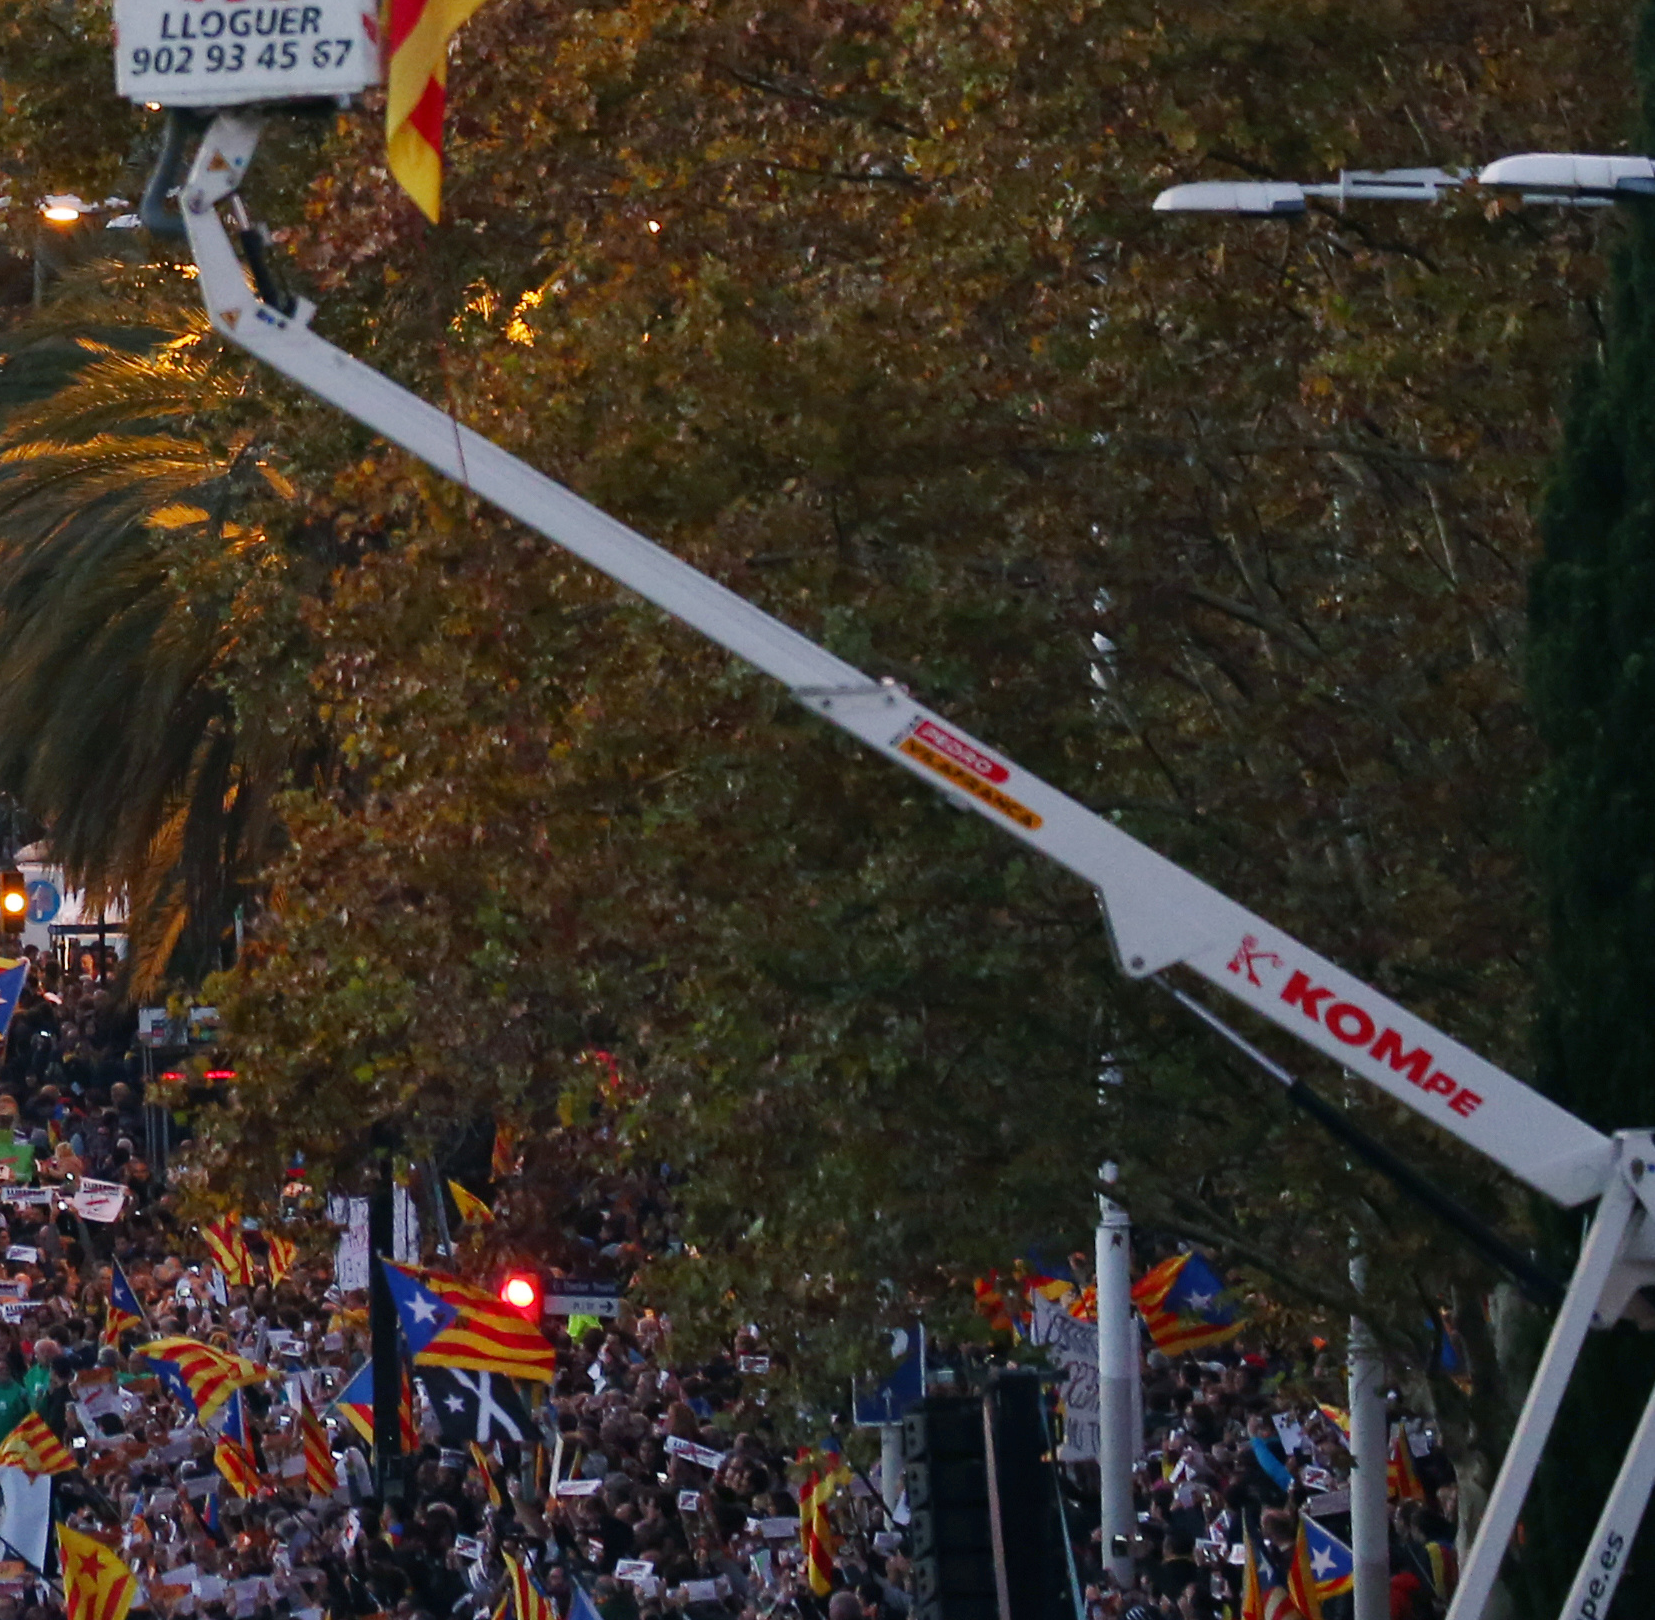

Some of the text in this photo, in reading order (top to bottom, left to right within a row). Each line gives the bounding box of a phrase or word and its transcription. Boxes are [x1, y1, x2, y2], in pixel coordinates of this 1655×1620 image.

[160, 6, 322, 40] LLOGUER
[131, 45, 192, 77] 902
[205, 43, 245, 73] 93
[257, 40, 298, 70] 45
[1280, 969, 1484, 1118] KOMPE
